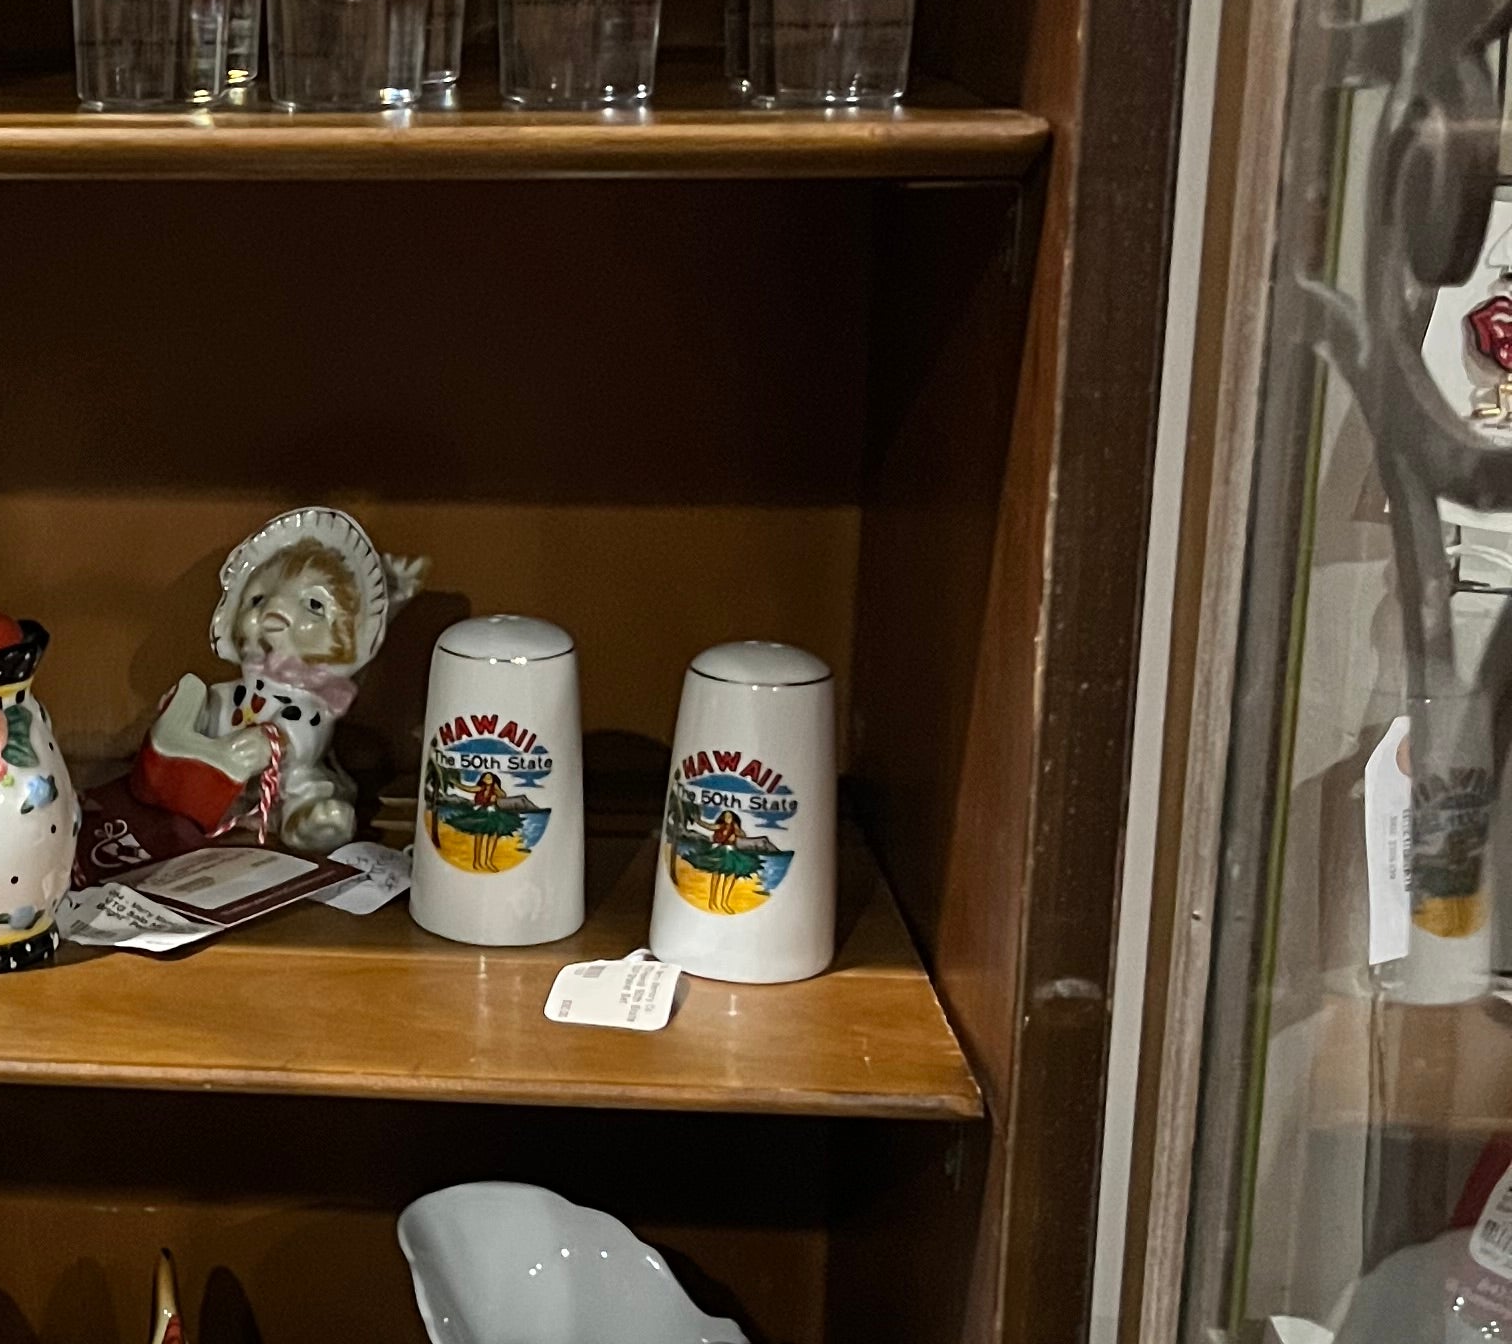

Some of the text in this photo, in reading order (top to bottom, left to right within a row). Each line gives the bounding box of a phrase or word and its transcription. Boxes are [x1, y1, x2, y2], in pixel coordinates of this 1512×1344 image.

[439, 713, 538, 754] HAWAII
[460, 754, 502, 771] 50th
[507, 755, 553, 773] State
[682, 750, 783, 794] HAWAII
[701, 789, 742, 809] 50th
[749, 795, 799, 812] State
